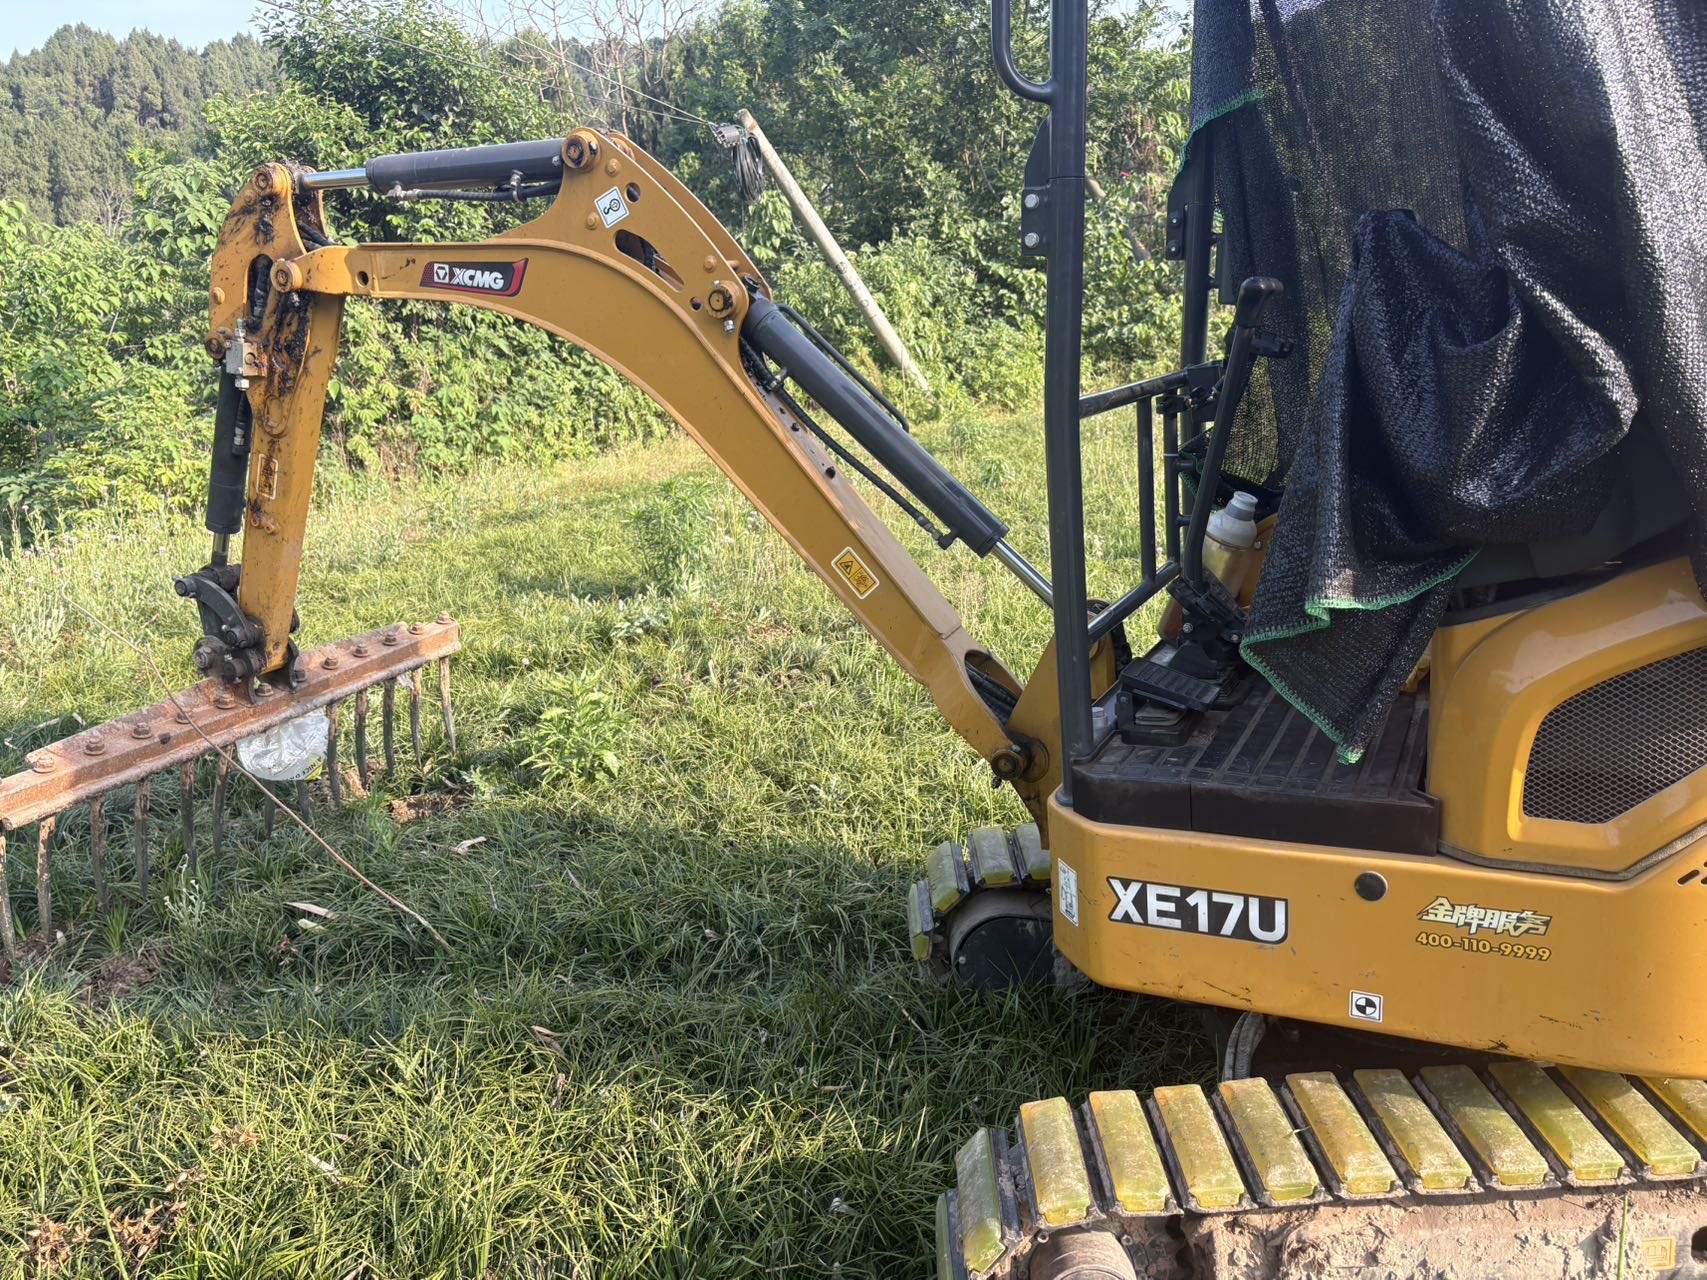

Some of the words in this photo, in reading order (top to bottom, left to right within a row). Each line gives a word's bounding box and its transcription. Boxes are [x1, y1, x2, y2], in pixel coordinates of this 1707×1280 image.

[450, 267, 504, 290] XCMG
[1109, 879, 1286, 942] XE17U
[1416, 932, 1551, 961] 400-110-9999
